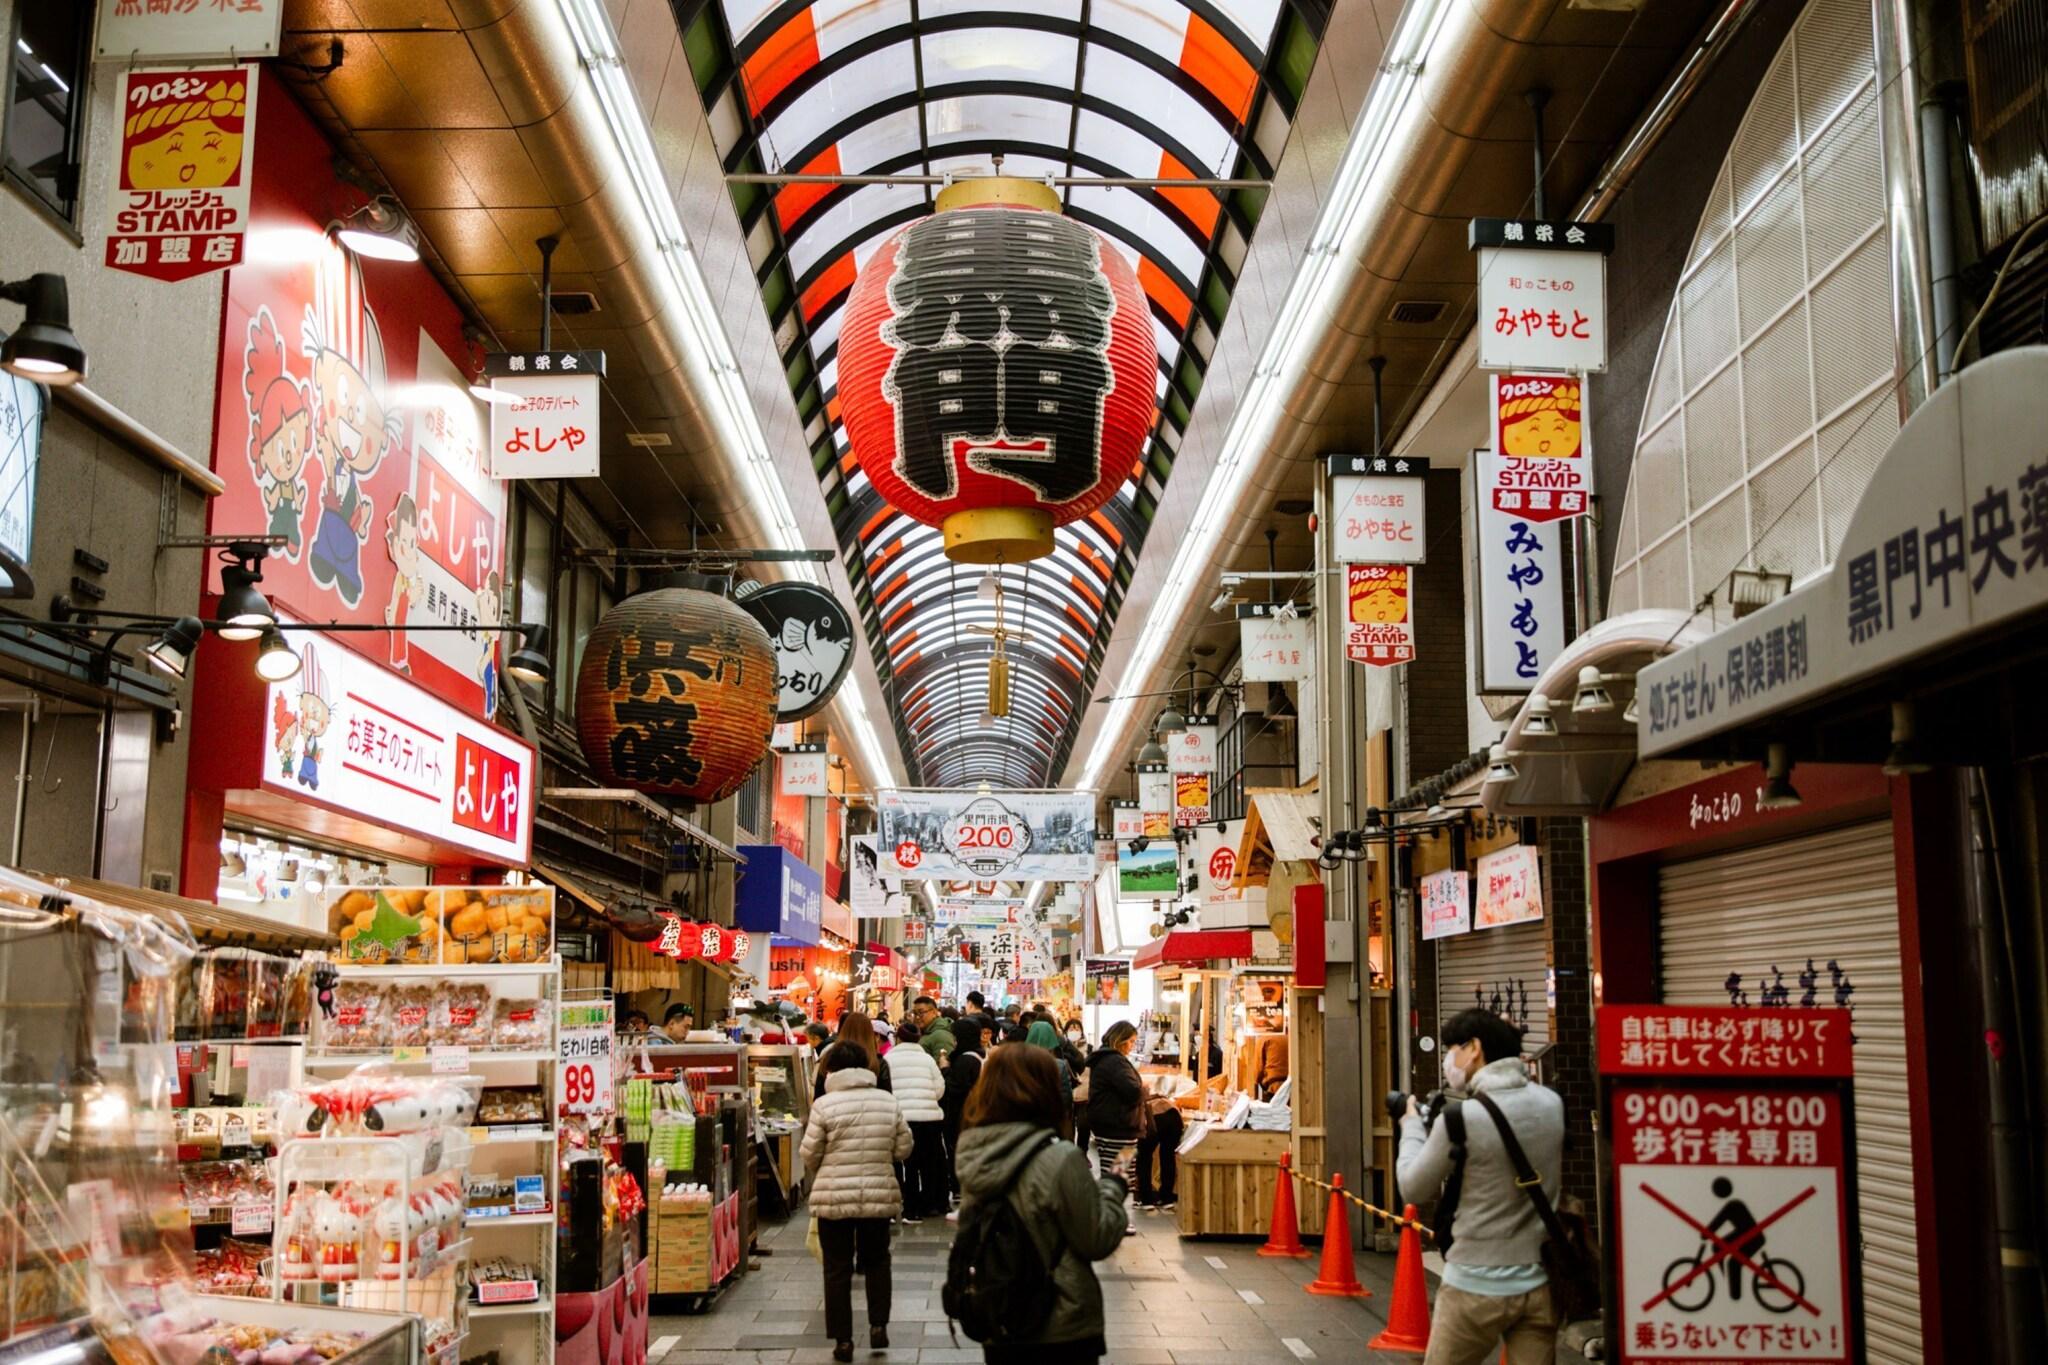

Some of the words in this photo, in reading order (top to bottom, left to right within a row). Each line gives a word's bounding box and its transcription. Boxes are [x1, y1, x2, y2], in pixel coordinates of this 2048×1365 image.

[130, 78, 208, 109] クロモン
[129, 190, 224, 209] フレッシュ
[117, 209, 237, 233] STAMP
[114, 237, 236, 264] 加盟店
[1509, 277, 1574, 292] 和のこもの
[1495, 307, 1590, 338] みやもと
[1500, 380, 1553, 399] クロモン
[505, 427, 586, 453] よしや
[1506, 458, 1571, 471] フレッシュ
[1499, 471, 1582, 488] STAMP
[1499, 491, 1582, 510] 加盟店
[419, 471, 492, 585] よしや
[1346, 518, 1413, 542] みやもと
[1847, 464, 2048, 645] 黒門中央薬
[1350, 567, 1388, 582] クロモン
[1506, 522, 1543, 678] みやもと
[1350, 633, 1408, 644] STAMP
[1355, 623, 1401, 634] フレッシュ
[1351, 646, 1409, 659] 加盟店
[347, 717, 443, 788] お菓子のデパート
[455, 747, 520, 833] よしや
[964, 814, 1010, 825] 黒門市場
[1689, 792, 1742, 829] 和のこもの
[958, 826, 1014, 849] 200
[900, 847, 919, 864] 祝
[1621, 1017, 1830, 1041] 自転車は必ず降りて
[1621, 1042, 1826, 1067] 通行してください！
[565, 1064, 595, 1104] 89
[1632, 1128, 1818, 1163] 歩行者専用
[1635, 1322, 1838, 1350] 乗らないで下さい！
